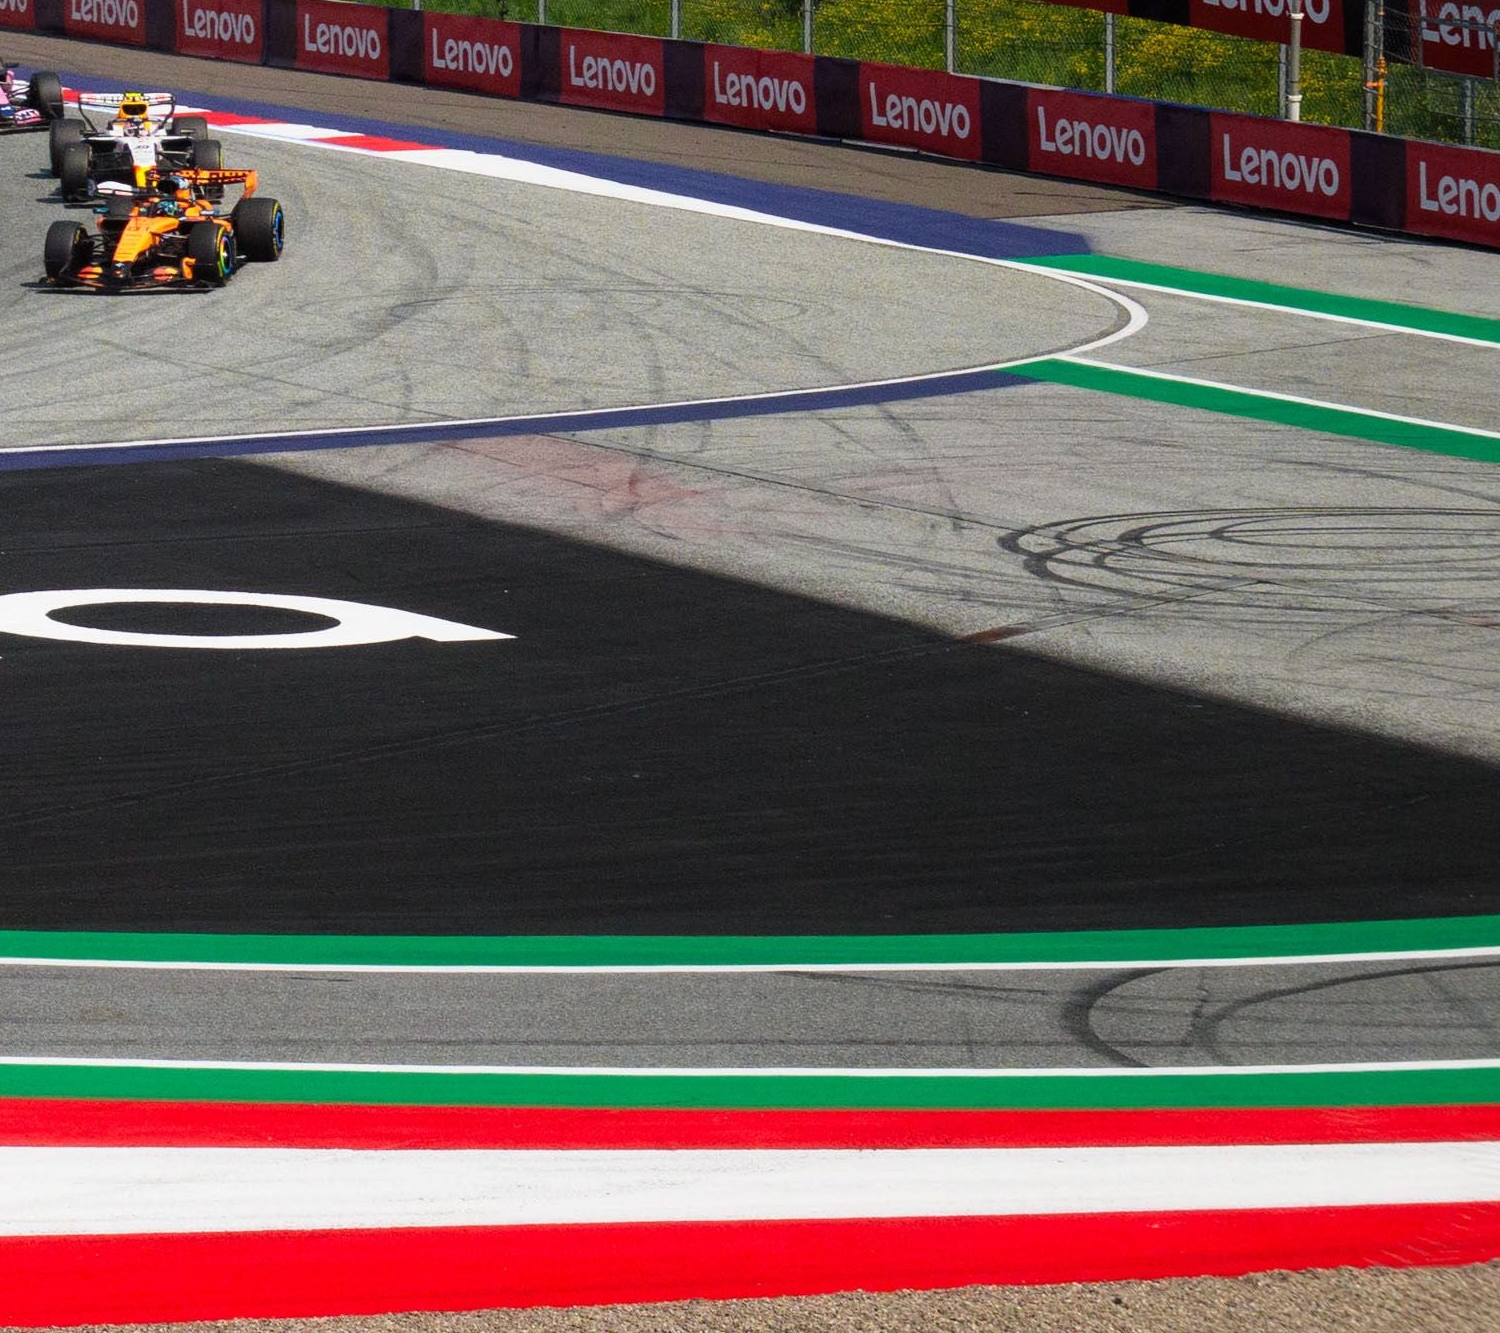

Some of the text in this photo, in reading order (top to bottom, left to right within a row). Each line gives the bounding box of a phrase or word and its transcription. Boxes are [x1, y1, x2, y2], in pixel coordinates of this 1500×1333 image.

[183, 0, 255, 44] Lenovo
[304, 14, 381, 60] Lenovo
[431, 28, 514, 77] Lenovo
[569, 45, 655, 96] Lenovo
[713, 61, 805, 114] Lenovo
[869, 82, 970, 139] Lenovo
[1037, 106, 1145, 165] Lenovo
[1222, 134, 1340, 196] Lenovo
[1418, 161, 1500, 221] Leno
